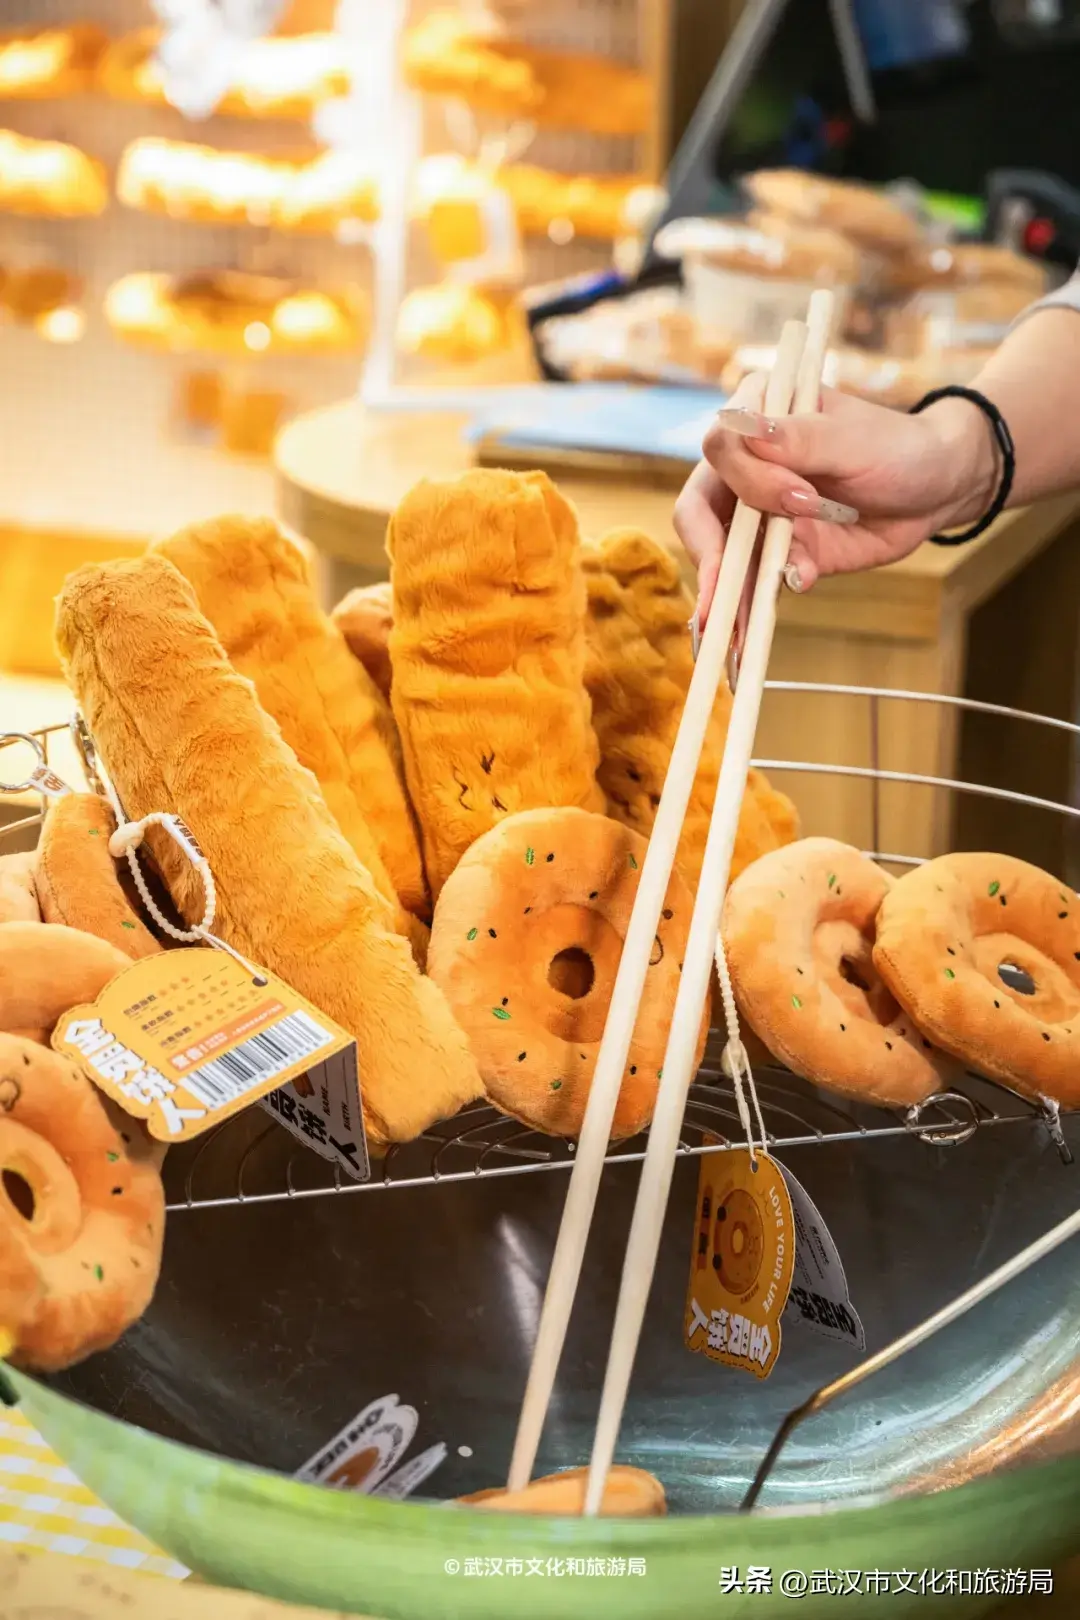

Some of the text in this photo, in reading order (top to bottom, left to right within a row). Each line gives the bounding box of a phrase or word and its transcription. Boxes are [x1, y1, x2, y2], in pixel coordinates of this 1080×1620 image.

[263, 1087, 360, 1172] 员饿人
[762, 1186, 785, 1314] LOVE YOUR LIFE
